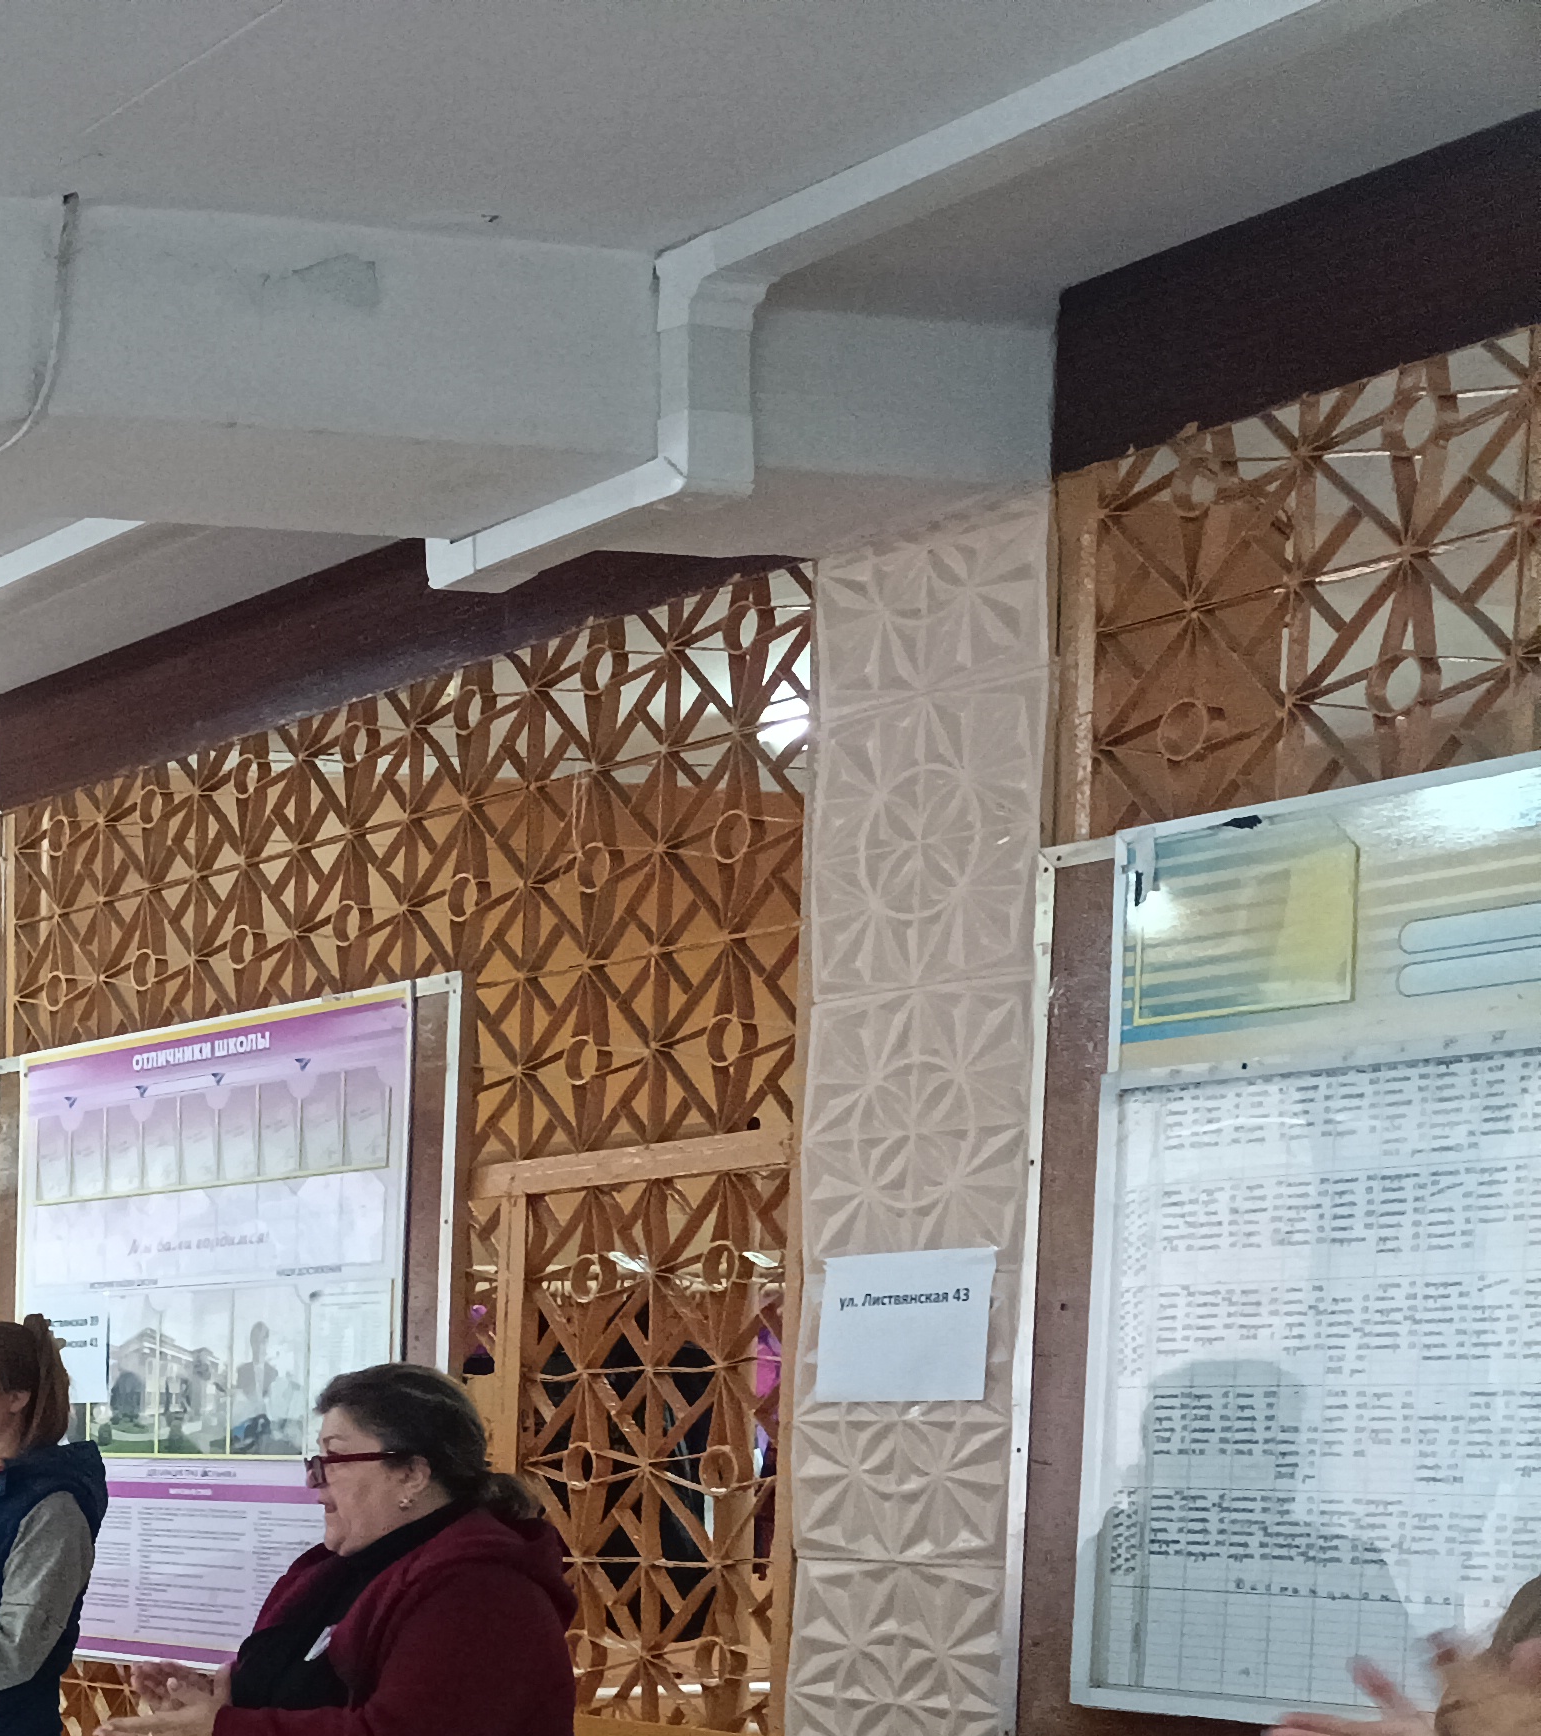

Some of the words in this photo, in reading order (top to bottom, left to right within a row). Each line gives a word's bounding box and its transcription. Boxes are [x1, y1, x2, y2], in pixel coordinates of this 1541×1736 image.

[132, 1041, 212, 1071] ОТЛИЧНИКИ
[214, 1031, 270, 1057] ШКОЛЫ
[839, 1296, 859, 1311] ул.
[861, 1291, 949, 1307] Листвянская
[952, 1287, 970, 1302] 43
